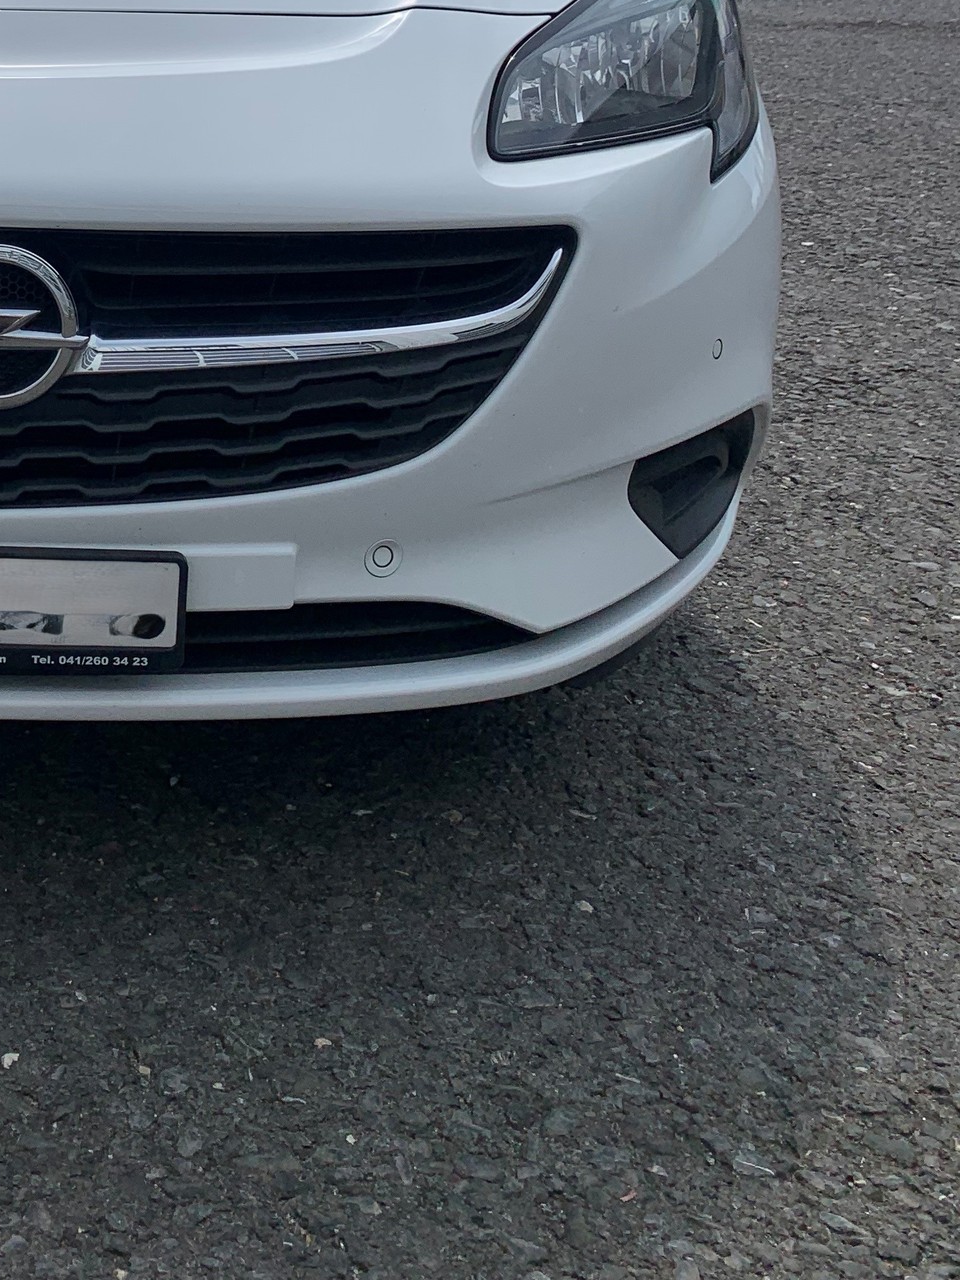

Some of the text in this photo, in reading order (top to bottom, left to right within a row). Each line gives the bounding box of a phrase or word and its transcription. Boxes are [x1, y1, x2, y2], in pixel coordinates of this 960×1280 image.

[31, 655, 149, 666] Tel. 041/260 34 23
